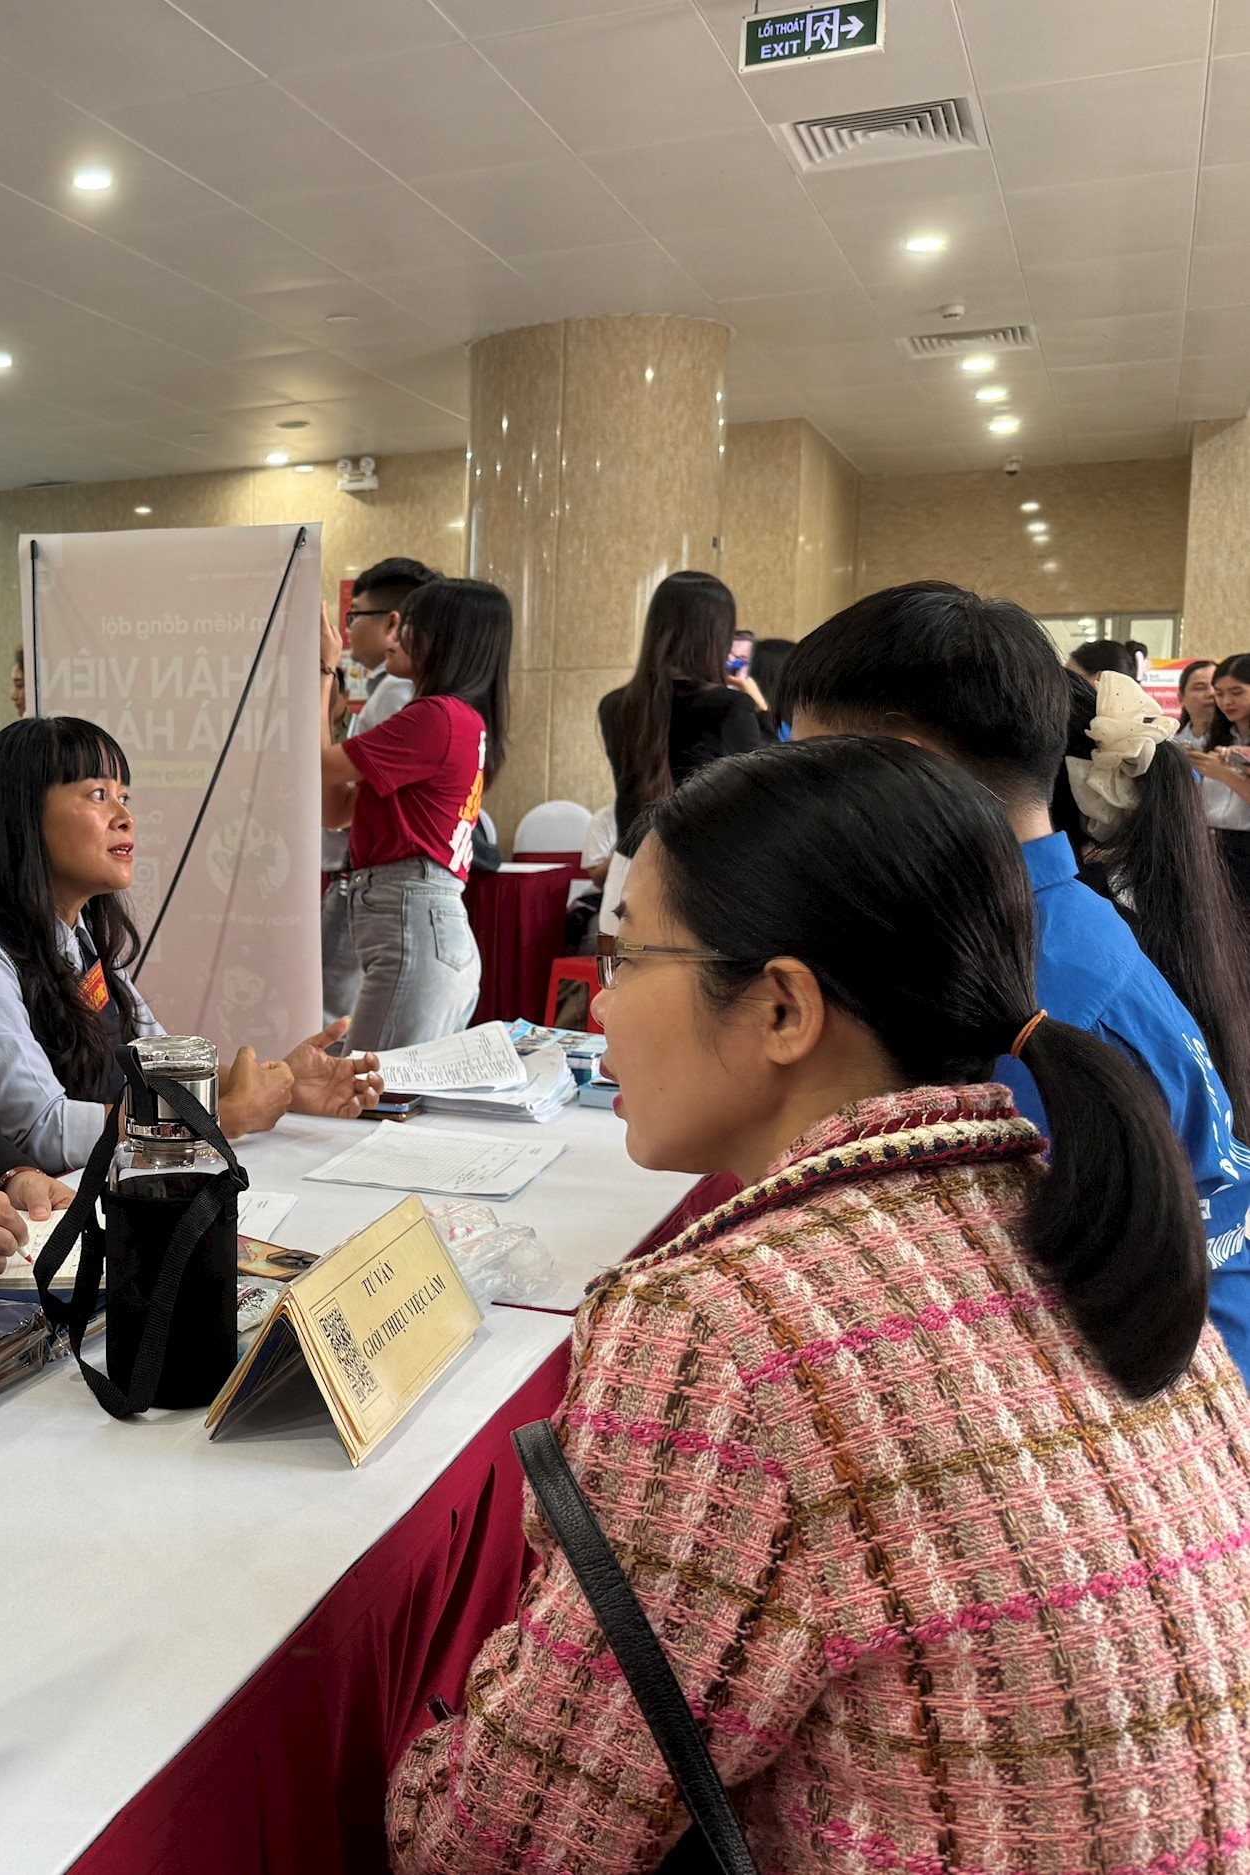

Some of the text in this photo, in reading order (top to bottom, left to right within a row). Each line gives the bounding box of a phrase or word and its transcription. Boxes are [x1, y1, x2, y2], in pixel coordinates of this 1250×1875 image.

[775, 17, 805, 36] THOÁT
[760, 39, 801, 59] EXIT
[361, 1259, 396, 1297] TƯ VẤN
[362, 1274, 446, 1360] GIỚI THIỆU VIỆC LÀM
